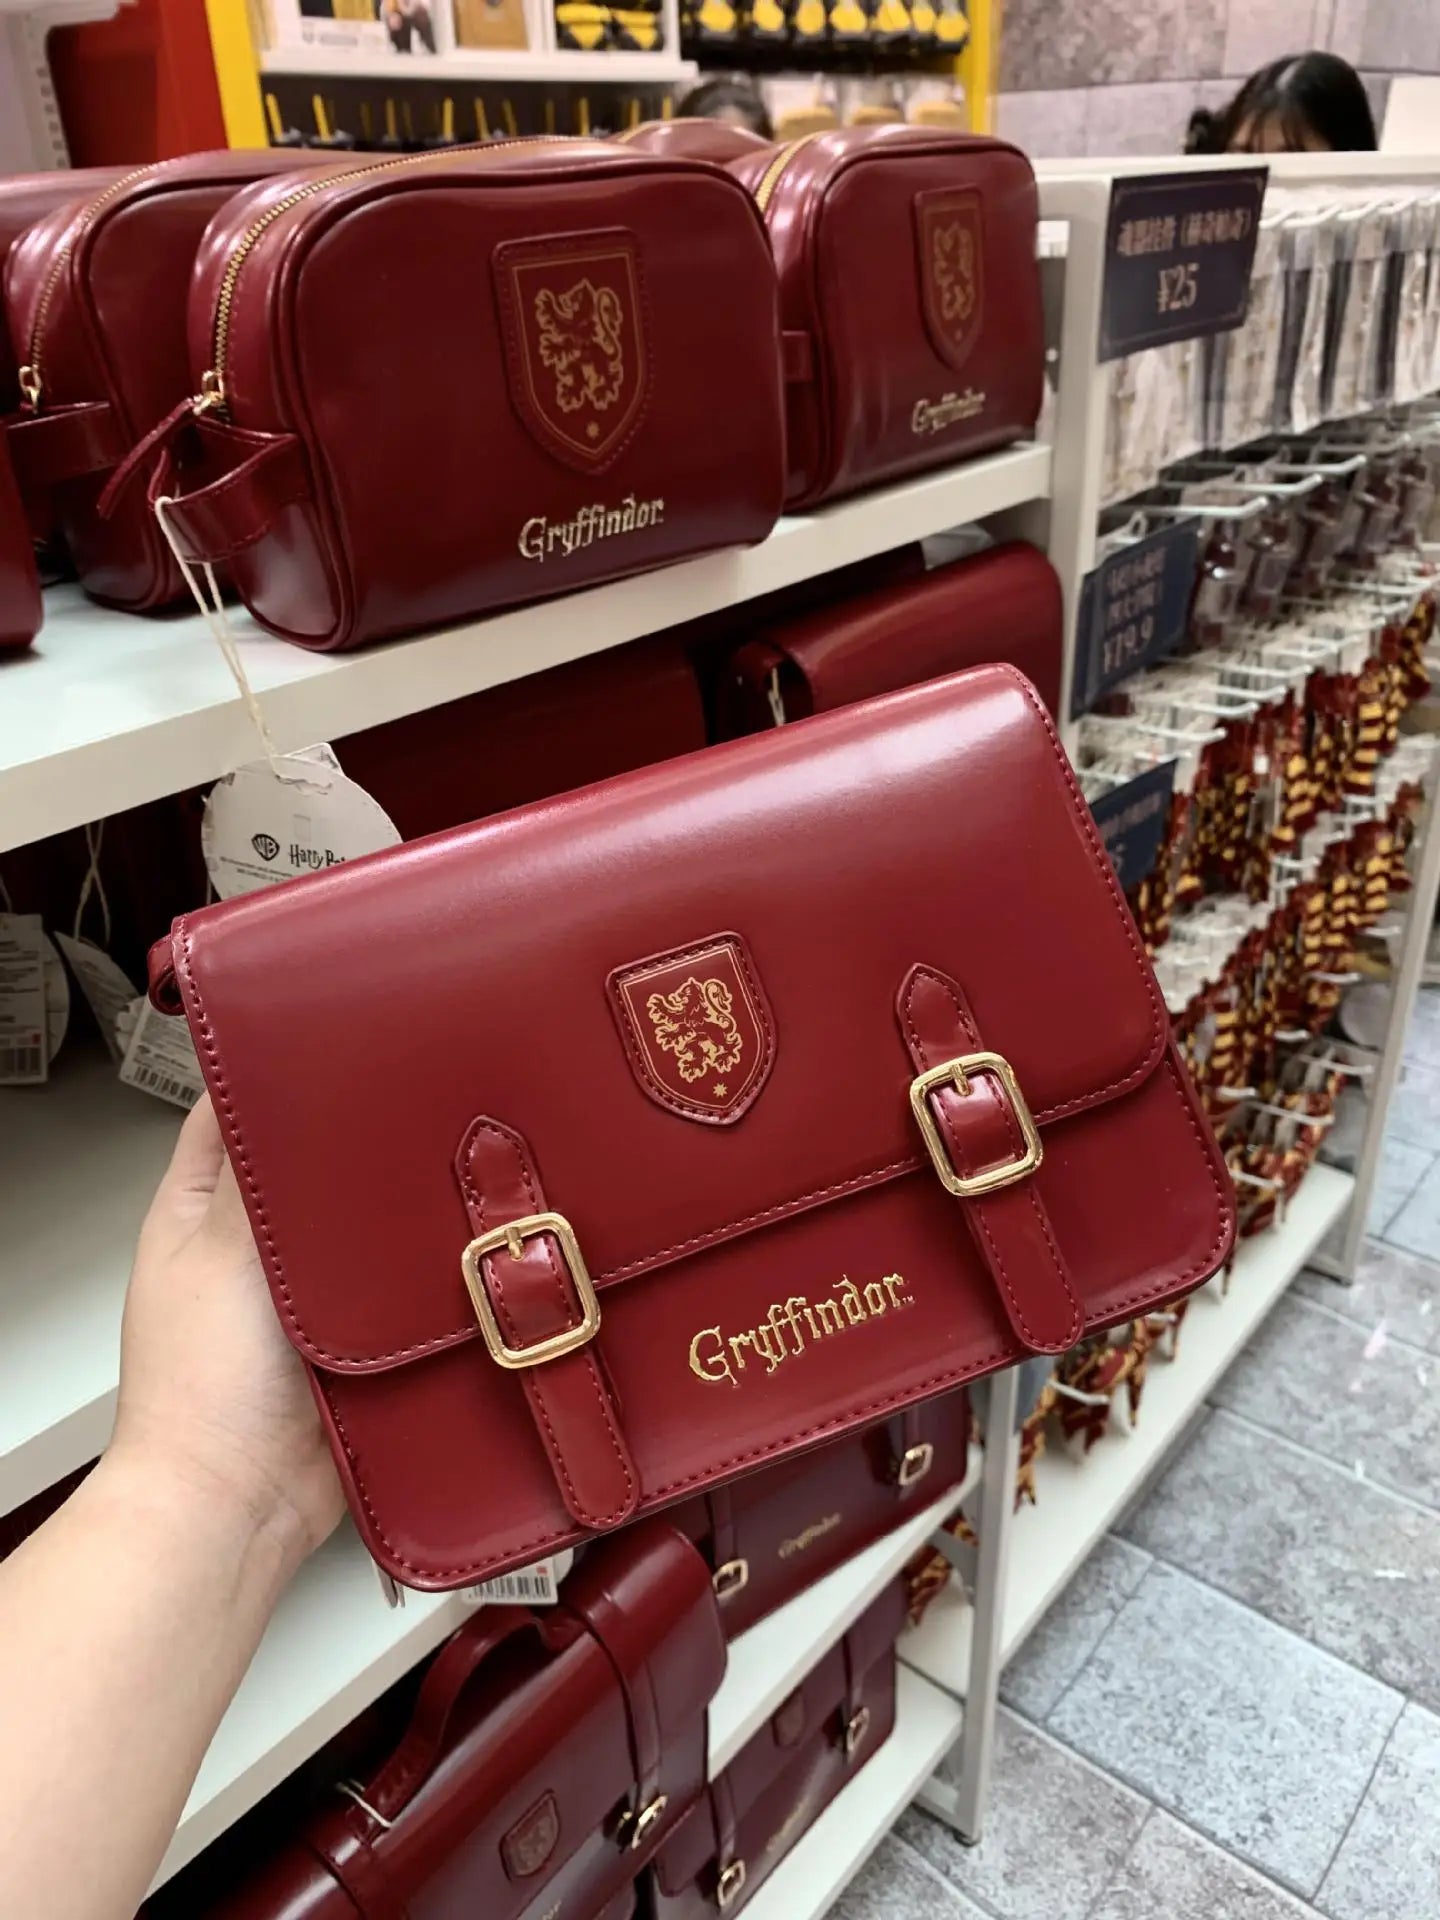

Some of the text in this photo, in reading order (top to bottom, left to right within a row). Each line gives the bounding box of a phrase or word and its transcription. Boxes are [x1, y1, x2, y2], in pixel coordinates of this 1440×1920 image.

[1158, 263, 1199, 313] ¥25
[518, 493, 664, 562] Gryffindor
[289, 844, 323, 870] Harry
[690, 1273, 903, 1387] Gryffindor
